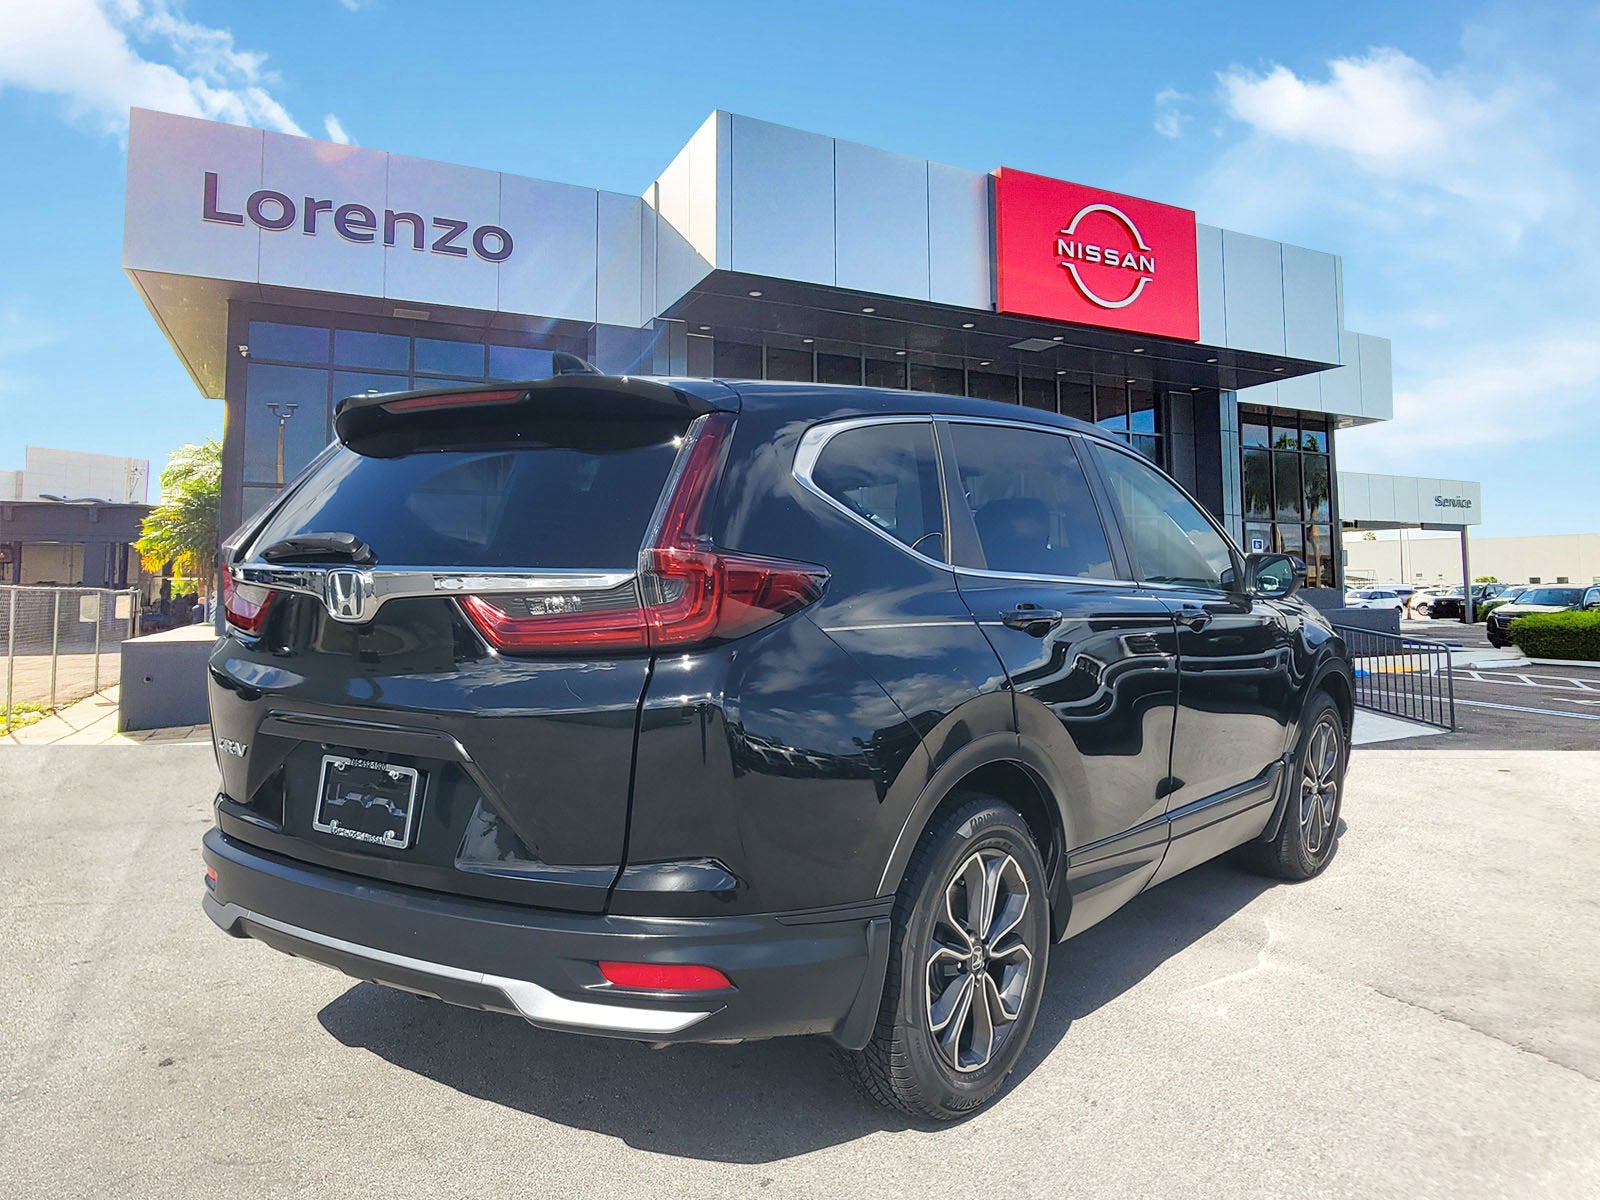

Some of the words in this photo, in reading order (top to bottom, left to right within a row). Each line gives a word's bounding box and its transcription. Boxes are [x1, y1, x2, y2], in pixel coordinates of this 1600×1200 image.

[202, 171, 514, 262] Lorenzo
[1057, 238, 1155, 273] NISSAN
[1434, 495, 1472, 509] Service
